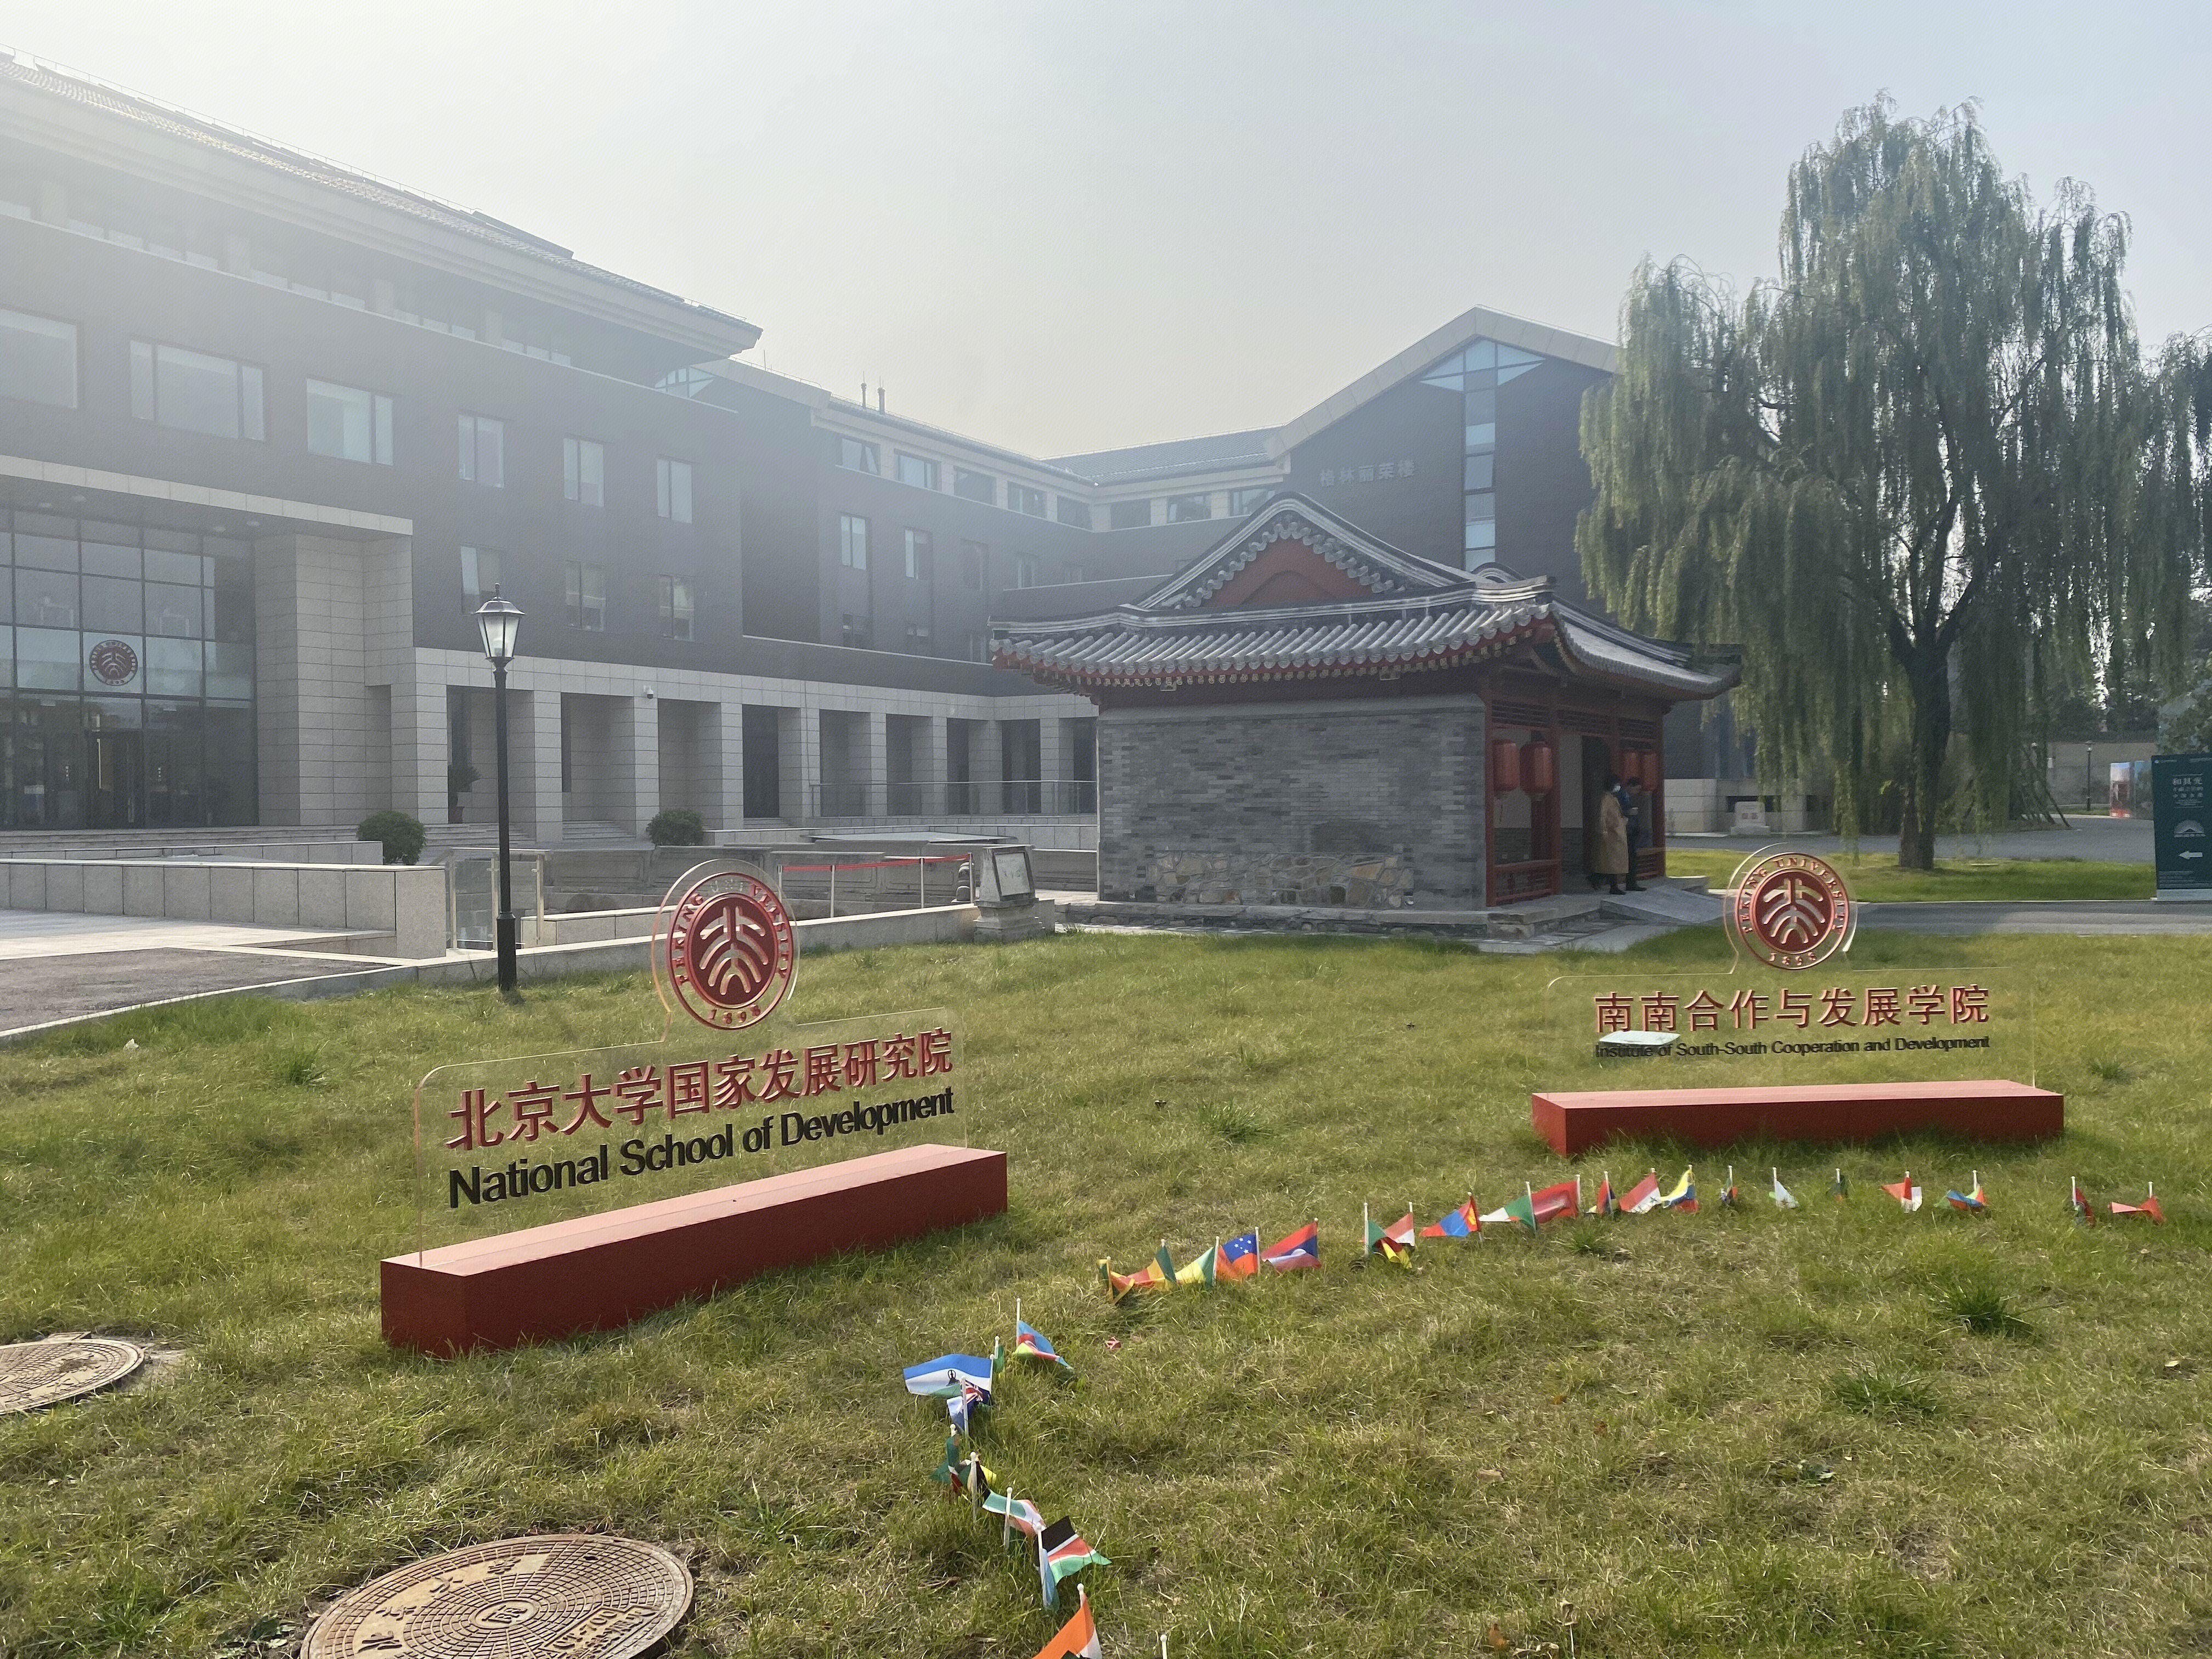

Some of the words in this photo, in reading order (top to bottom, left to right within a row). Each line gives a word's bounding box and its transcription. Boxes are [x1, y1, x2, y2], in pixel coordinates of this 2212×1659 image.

[1739, 867, 1768, 932] PEKING
[1773, 857, 1845, 932] UNIVERSITY
[1768, 952, 1818, 966] 1898
[708, 1004, 761, 1024] 1898
[1593, 984, 1990, 1033] 南南合作与发展学院
[1595, 1044, 1654, 1058] Institute
[1657, 1042, 1672, 1056] of
[1675, 1041, 1767, 1057] South-South
[1772, 1040, 1860, 1056] Cooperation
[1864, 1038, 1891, 1052] and
[1895, 1036, 1990, 1052] Development
[445, 1027, 952, 1151] 北京大学国家发展研究院
[449, 1144, 608, 1208] National
[620, 1123, 733, 1176] School
[742, 1118, 774, 1153] of
[781, 1087, 954, 1146] Development
